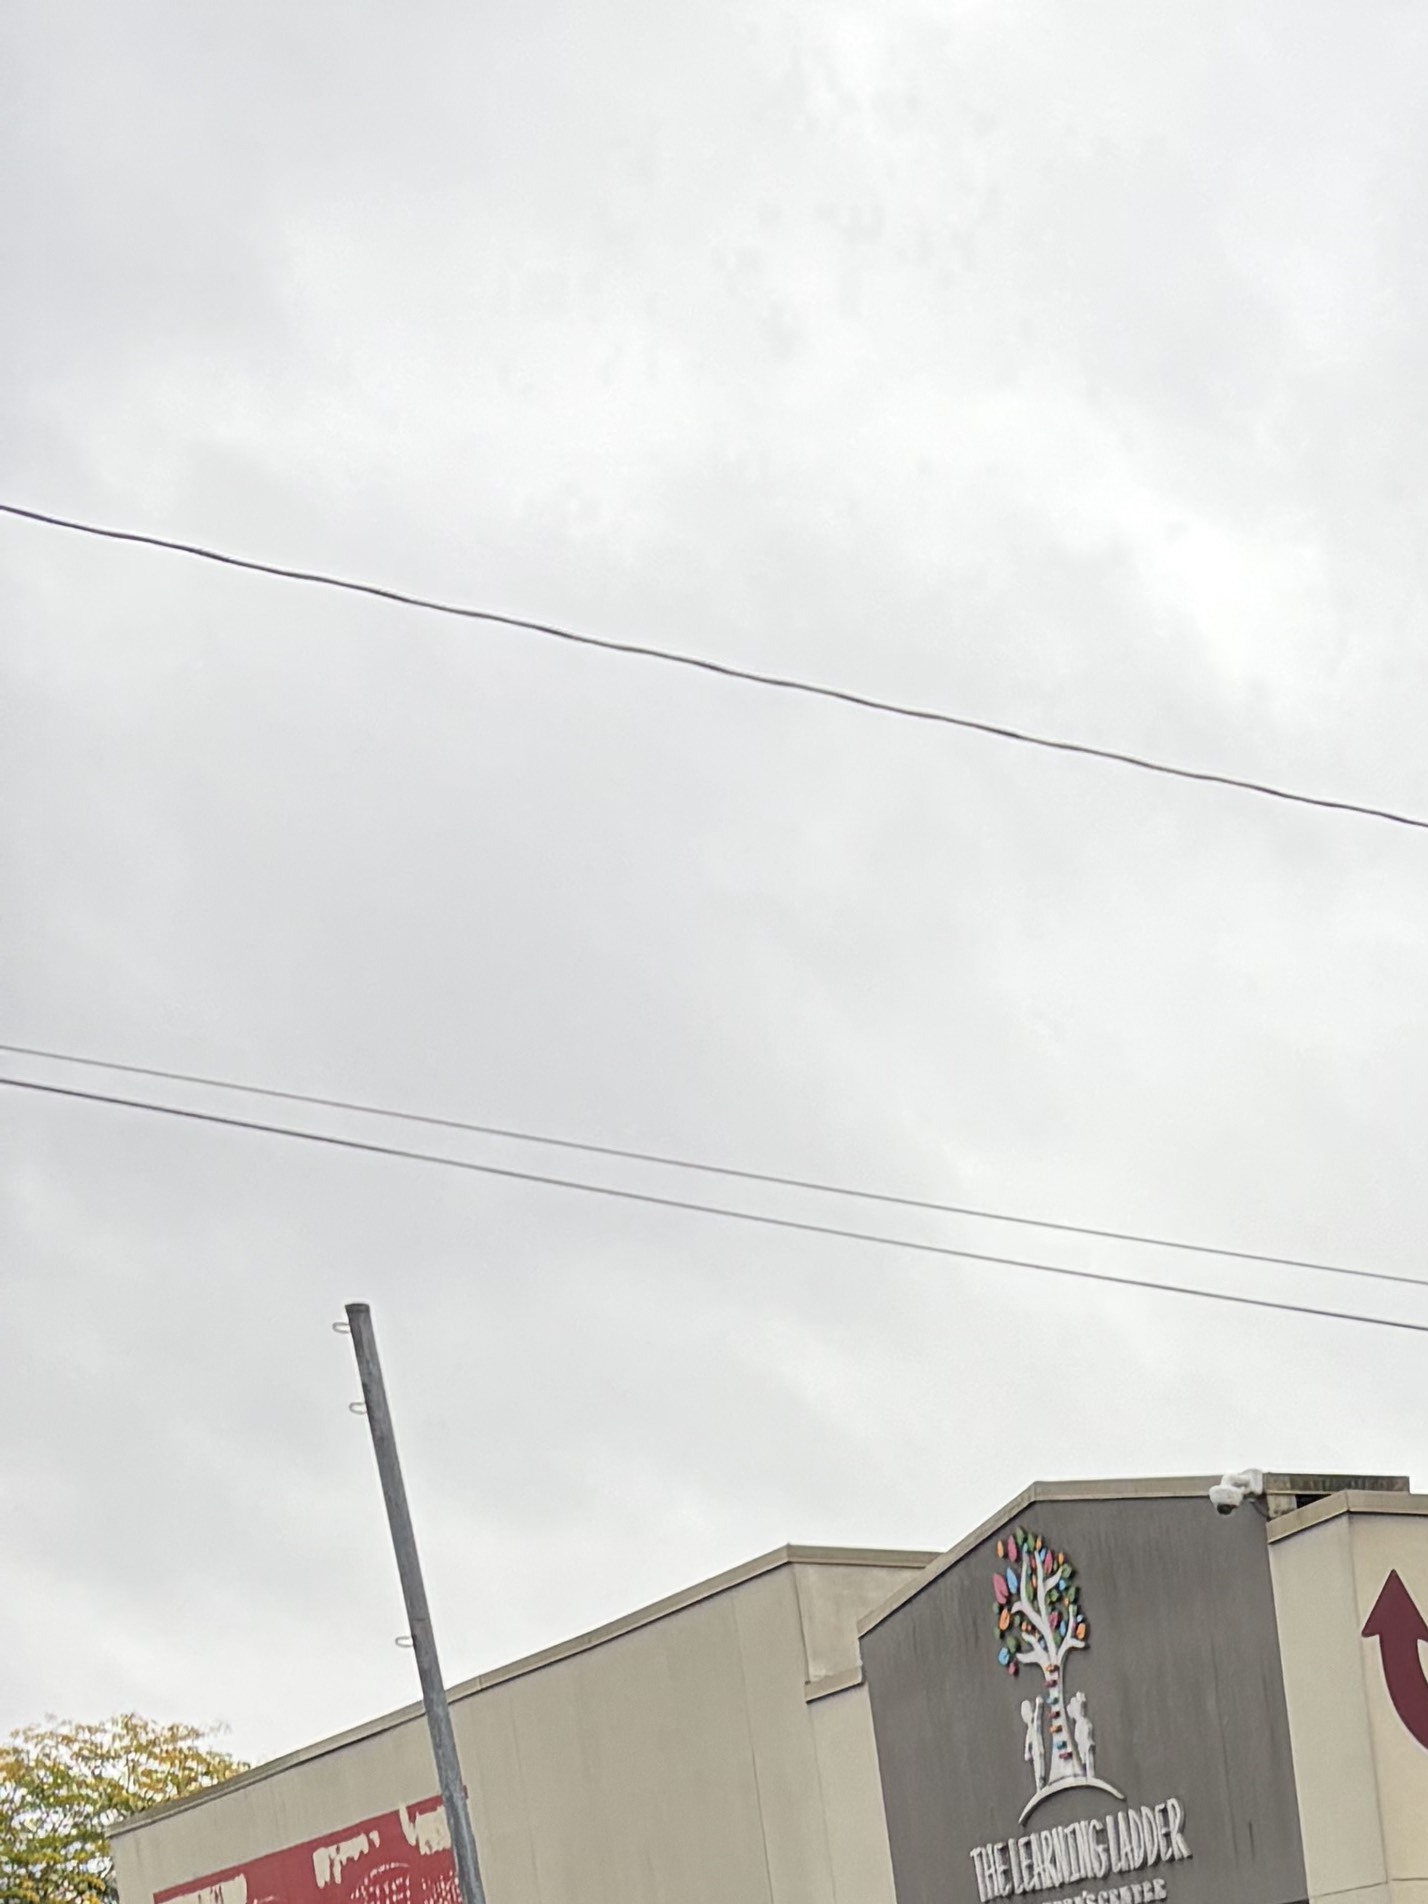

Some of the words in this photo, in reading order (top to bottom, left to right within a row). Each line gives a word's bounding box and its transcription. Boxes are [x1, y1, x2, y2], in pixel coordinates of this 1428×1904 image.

[969, 1841, 1012, 1903] THE
[1007, 1818, 1109, 1895] LEARNING
[1105, 1797, 1193, 1873] LADDER
